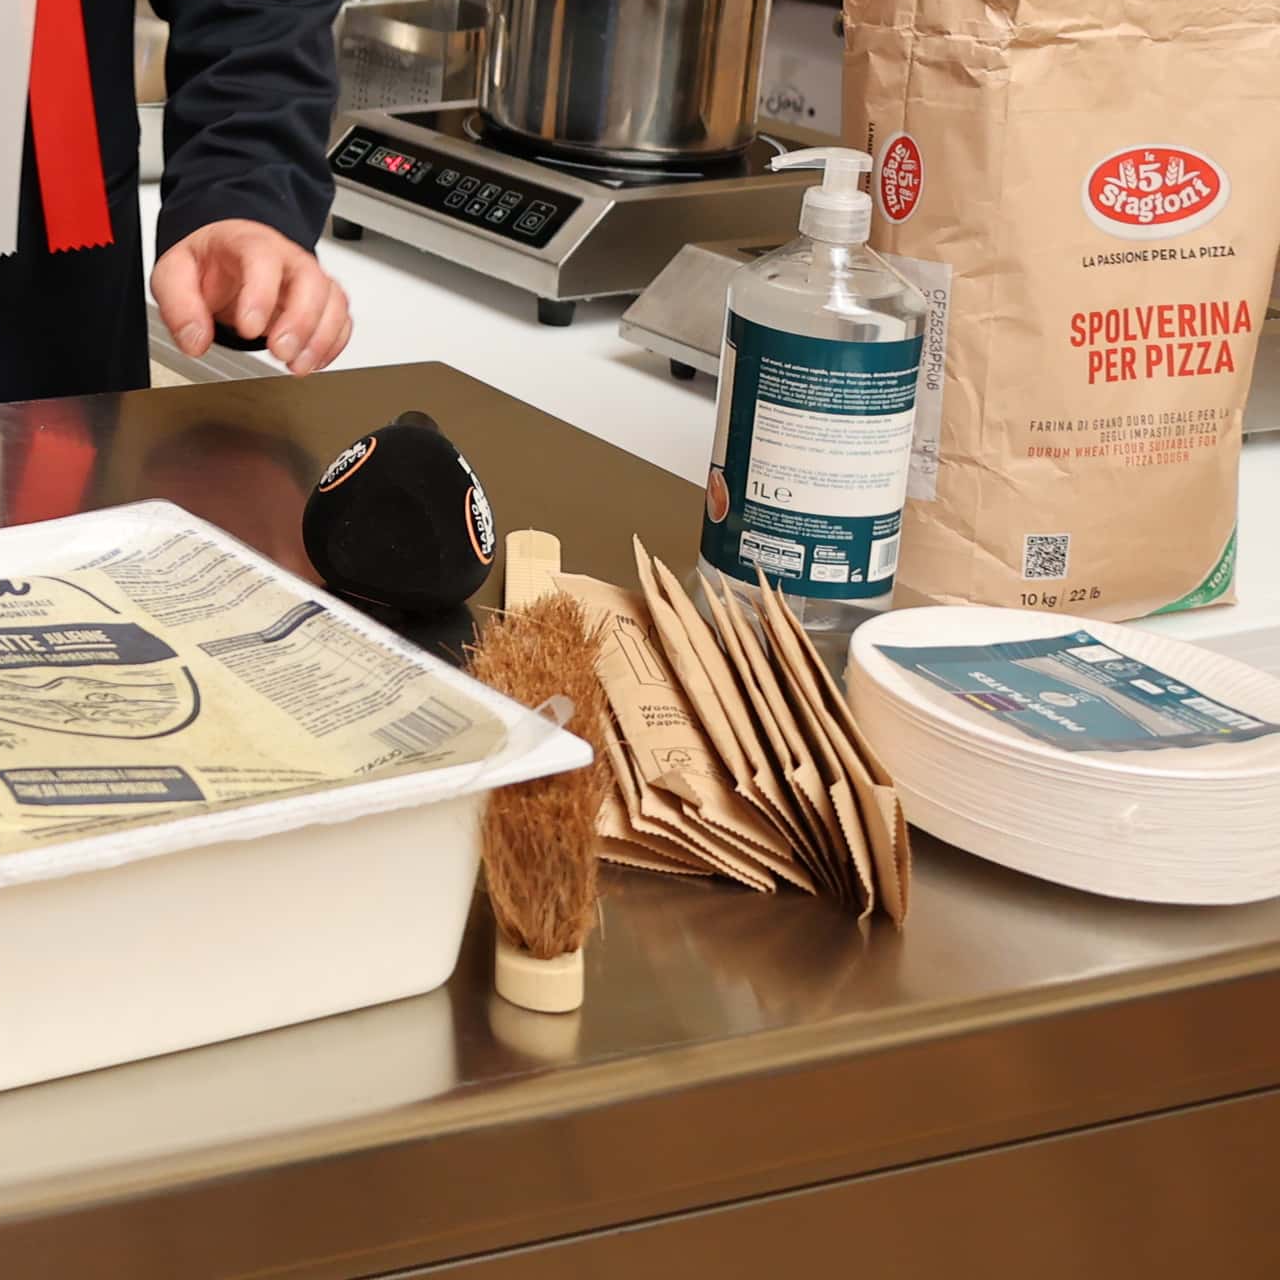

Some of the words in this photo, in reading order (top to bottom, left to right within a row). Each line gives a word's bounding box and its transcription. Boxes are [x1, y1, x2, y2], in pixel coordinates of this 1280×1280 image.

[1144, 151, 1155, 162] le
[1138, 162, 1164, 192] 5
[1098, 176, 1212, 223] Stagioni
[1082, 256, 1095, 268] LA
[1098, 250, 1149, 265] PASSIONE
[1151, 248, 1177, 261] PER
[1180, 247, 1196, 260] LA
[1199, 245, 1236, 258] PIZZA
[1070, 300, 1252, 347] SPOLVERINA
[1088, 346, 1137, 385] PER
[1146, 339, 1235, 379] PIZZA
[1029, 420, 1073, 433] FARINA
[1077, 419, 1089, 431] DI
[1092, 416, 1123, 431] GRANO
[1126, 414, 1155, 426] DURO
[1159, 410, 1193, 424] IDEALE
[1197, 408, 1216, 420] PER
[1099, 430, 1127, 443] DEGLI
[1129, 426, 1172, 440] IMPASTI
[1175, 425, 1186, 436] DI
[1189, 422, 1218, 434] PIZZA
[1027, 446, 1071, 458] DURUM
[1074, 444, 1110, 457] WHEAT
[1113, 442, 1145, 455] FLOUR
[1149, 437, 1194, 451] SUITABLE
[1198, 435, 1217, 447] FOR
[1125, 454, 1154, 467] PIZZA
[1157, 451, 1190, 465] DOUGH
[751, 481, 771, 500] 1L
[1020, 592, 1038, 607] 10
[1040, 591, 1057, 608] kg
[1068, 588, 1086, 602] 22
[1089, 586, 1101, 600] lb
